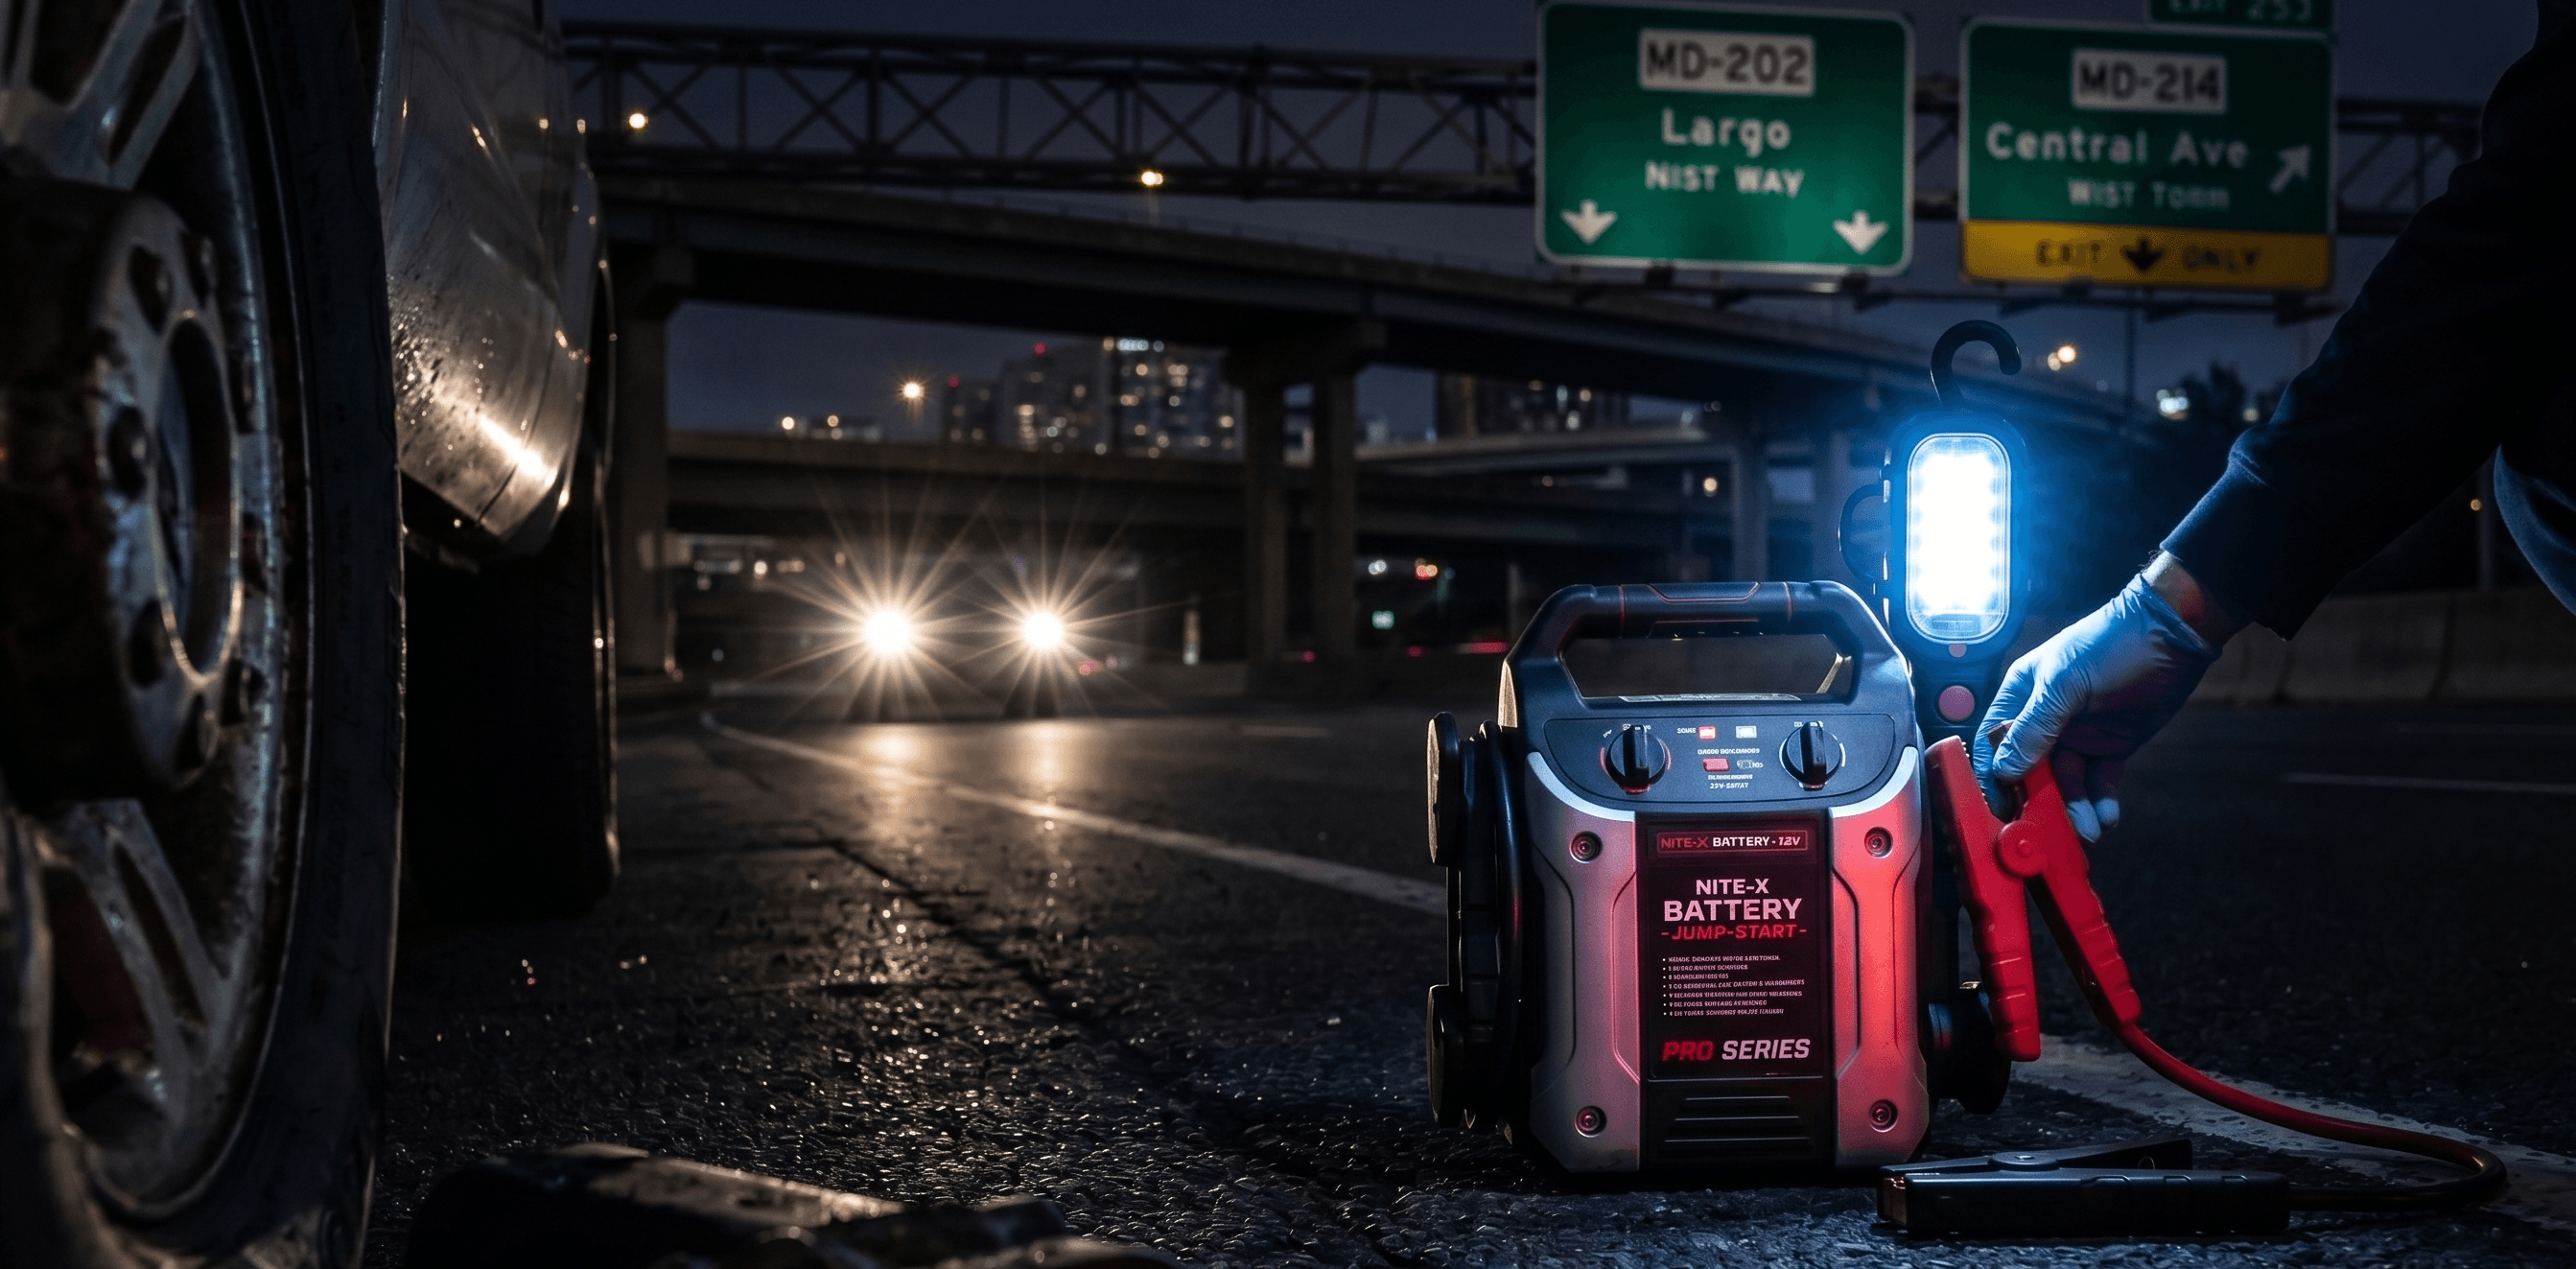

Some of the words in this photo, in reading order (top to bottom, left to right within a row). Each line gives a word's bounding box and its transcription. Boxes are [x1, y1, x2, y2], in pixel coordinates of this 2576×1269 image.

[1646, 41, 1809, 85] MD-202
[2079, 59, 2219, 104] MD-214
[1661, 107, 1791, 158] Largo
[1985, 121, 2147, 165] Central
[2169, 130, 2250, 169] Ave
[1734, 164, 1805, 199] WAY
[1660, 837, 1709, 848] NITE-X
[1712, 836, 1769, 847] BATTERY
[1778, 835, 1801, 846] 12V
[1696, 878, 1769, 895] NITE-X
[1664, 898, 1803, 922] BATTERY
[1662, 1040, 1714, 1062] PRO
[1721, 1038, 1811, 1060] SERIES
